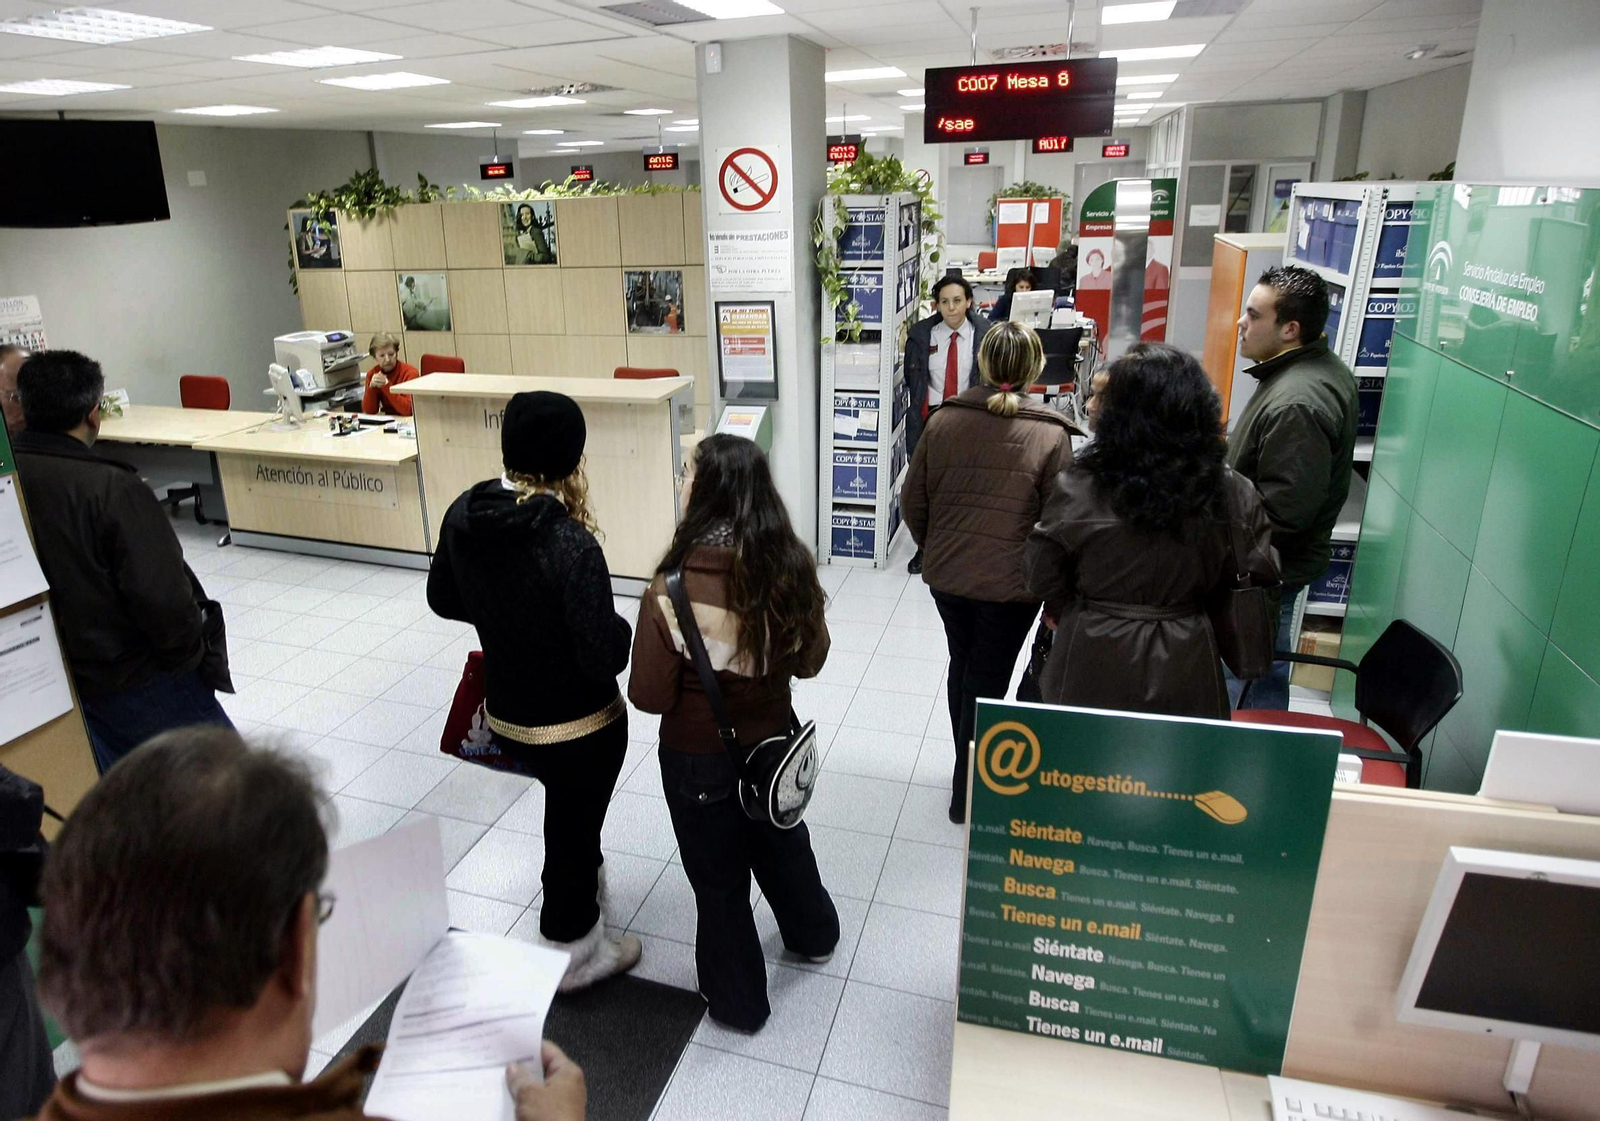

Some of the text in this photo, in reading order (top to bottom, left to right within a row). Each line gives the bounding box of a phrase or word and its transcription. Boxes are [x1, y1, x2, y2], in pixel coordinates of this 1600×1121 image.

[957, 70, 1069, 91] C007 Mesa 8
[658, 145, 664, 154] 3
[1385, 208, 1410, 220] OPY
[735, 231, 789, 241] PRESTACIONES
[1462, 260, 1545, 295] Servicio Andaluz de Empleo
[1367, 302, 1398, 313] COPY
[1459, 285, 1496, 310] CONSEJERÍA
[1496, 295, 1507, 312] DE
[1507, 297, 1538, 321] EMPLEO
[835, 399, 876, 408] OPY STAR
[484, 409, 505, 429] Inf
[835, 455, 855, 463] COPY
[256, 464, 384, 493] Atención al Público
[832, 518, 849, 526] COPY
[1086, 836, 1126, 851] Navega.
[1127, 840, 1160, 854] Busca.
[1162, 844, 1194, 858] Tienes
[1196, 850, 1209, 860] un
[1079, 865, 1111, 879] Busca.
[1113, 869, 1144, 882] Tienes
[1146, 874, 1159, 884] un
[1160, 877, 1193, 889] e.mail.
[1195, 879, 1239, 894] Siéntate.
[1061, 892, 1091, 904] Tienes
[1092, 898, 1105, 907] un
[1106, 899, 1138, 911] e.mail.
[1140, 902, 1182, 917] Siéntate.
[1185, 908, 1224, 923] Navega.
[1227, 913, 1235, 924] B
[969, 906, 999, 920] Busca.
[1000, 904, 1056, 929] Tienes
[1060, 916, 1083, 932] un
[1145, 932, 1187, 947] Siéntate.
[1189, 938, 1228, 953] Navega.
[991, 939, 1003, 948] un
[1108, 955, 1145, 970] Navega.
[1147, 961, 1179, 974] Busca.
[1181, 965, 1211, 979] Tienes
[1213, 972, 1226, 981] un
[1099, 982, 1130, 995] Busca.
[1132, 986, 1163, 1000] Tienes
[1164, 993, 1177, 1002] un
[1178, 995, 1210, 1007] e.mail.
[1212, 998, 1220, 1008] S
[960, 985, 990, 998] éntate.
[1083, 1006, 1113, 1020] Tienes
[1114, 1012, 1127, 1021] un
[1128, 1014, 1158, 1027] e.mail.
[1160, 1019, 1201, 1034] Siéntate.
[1026, 1015, 1080, 1040] Tienes
[1084, 1028, 1106, 1044] un
[1167, 1047, 1208, 1062] Siéntate.
